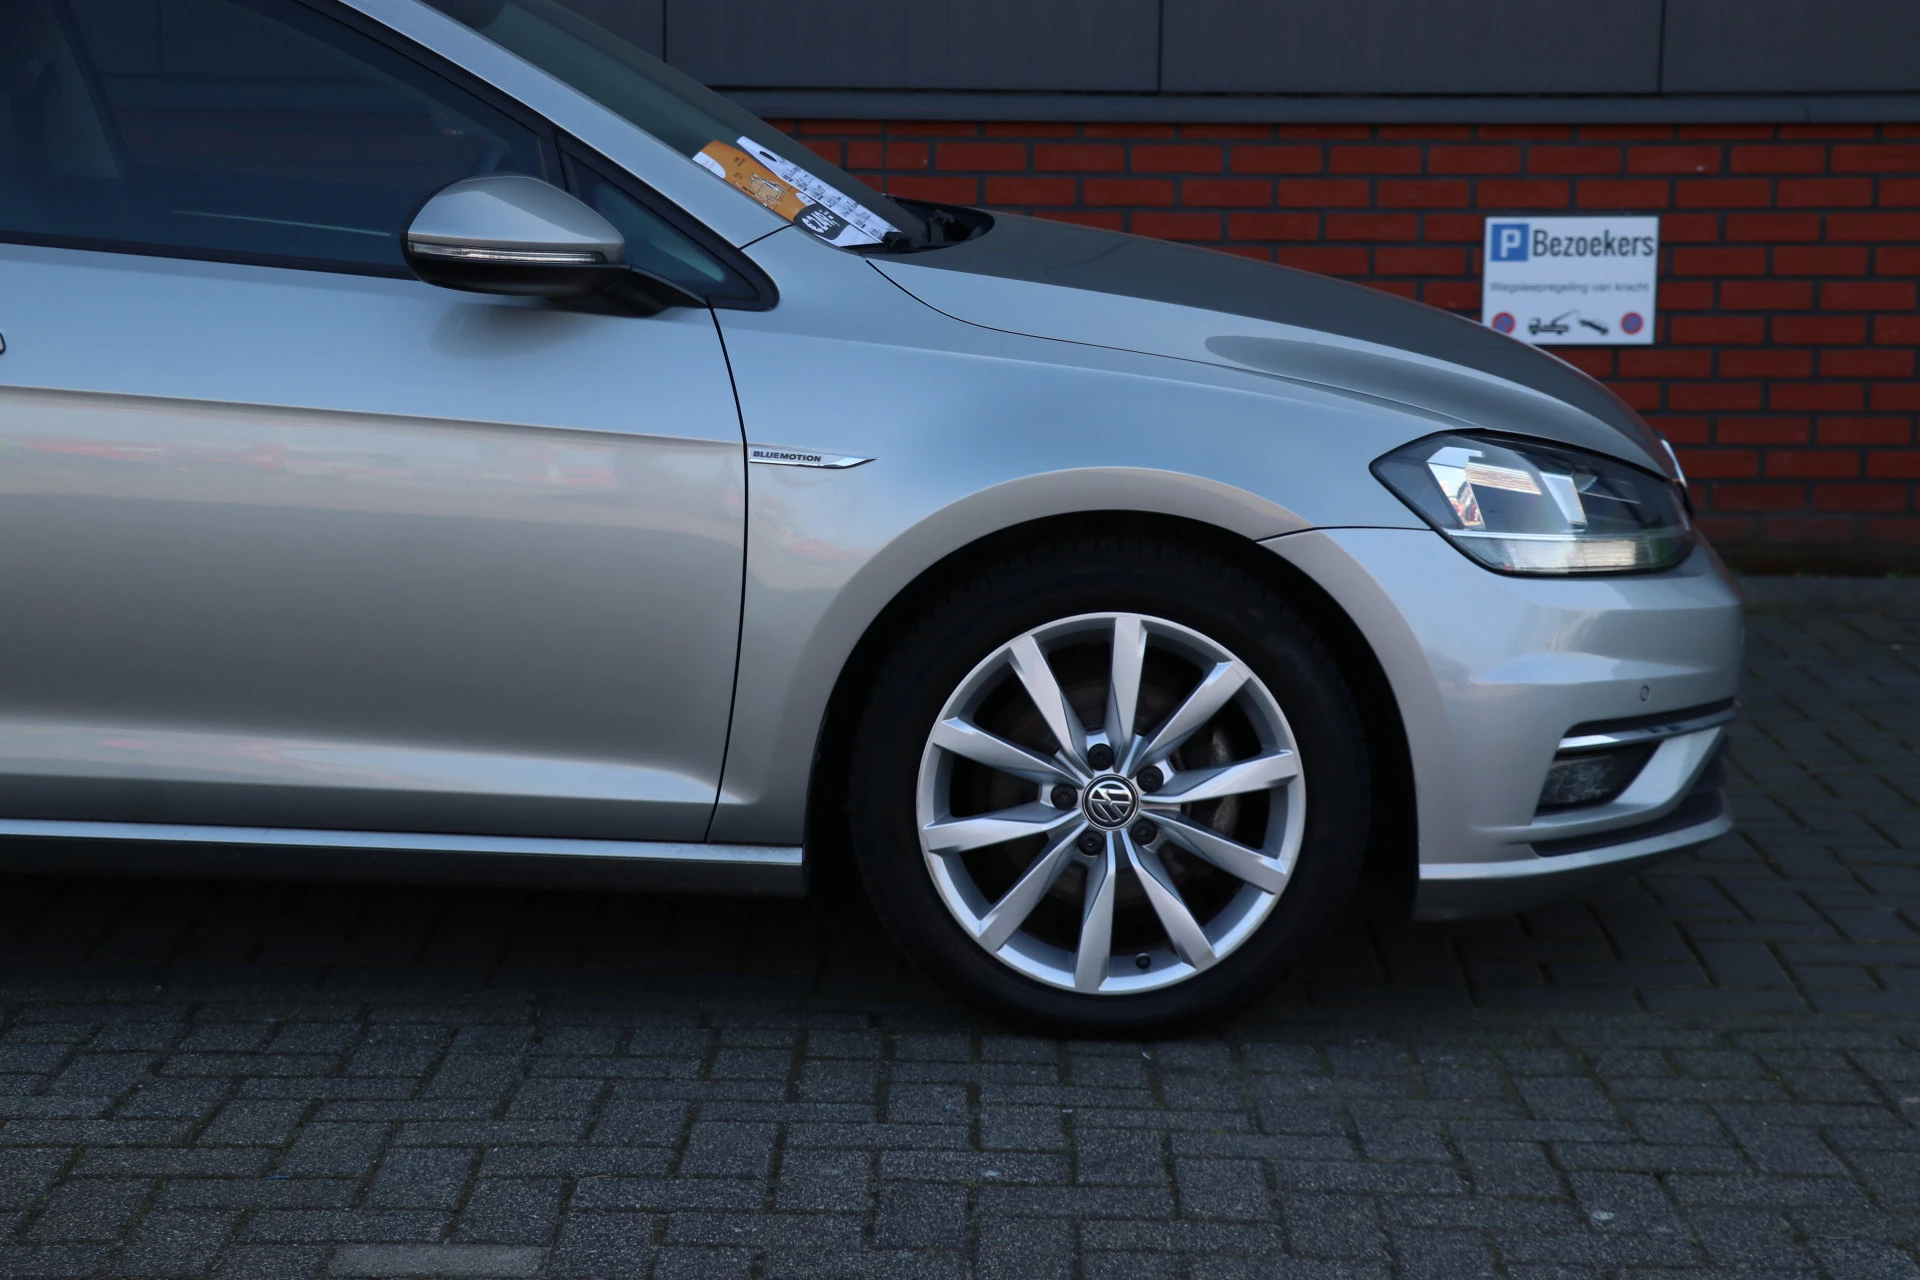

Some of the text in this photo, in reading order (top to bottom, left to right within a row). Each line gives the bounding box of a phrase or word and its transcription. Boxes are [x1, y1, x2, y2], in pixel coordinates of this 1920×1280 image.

[1501, 229, 1655, 258] P Bezoekers
[752, 450, 822, 463] BLUEMOTION
